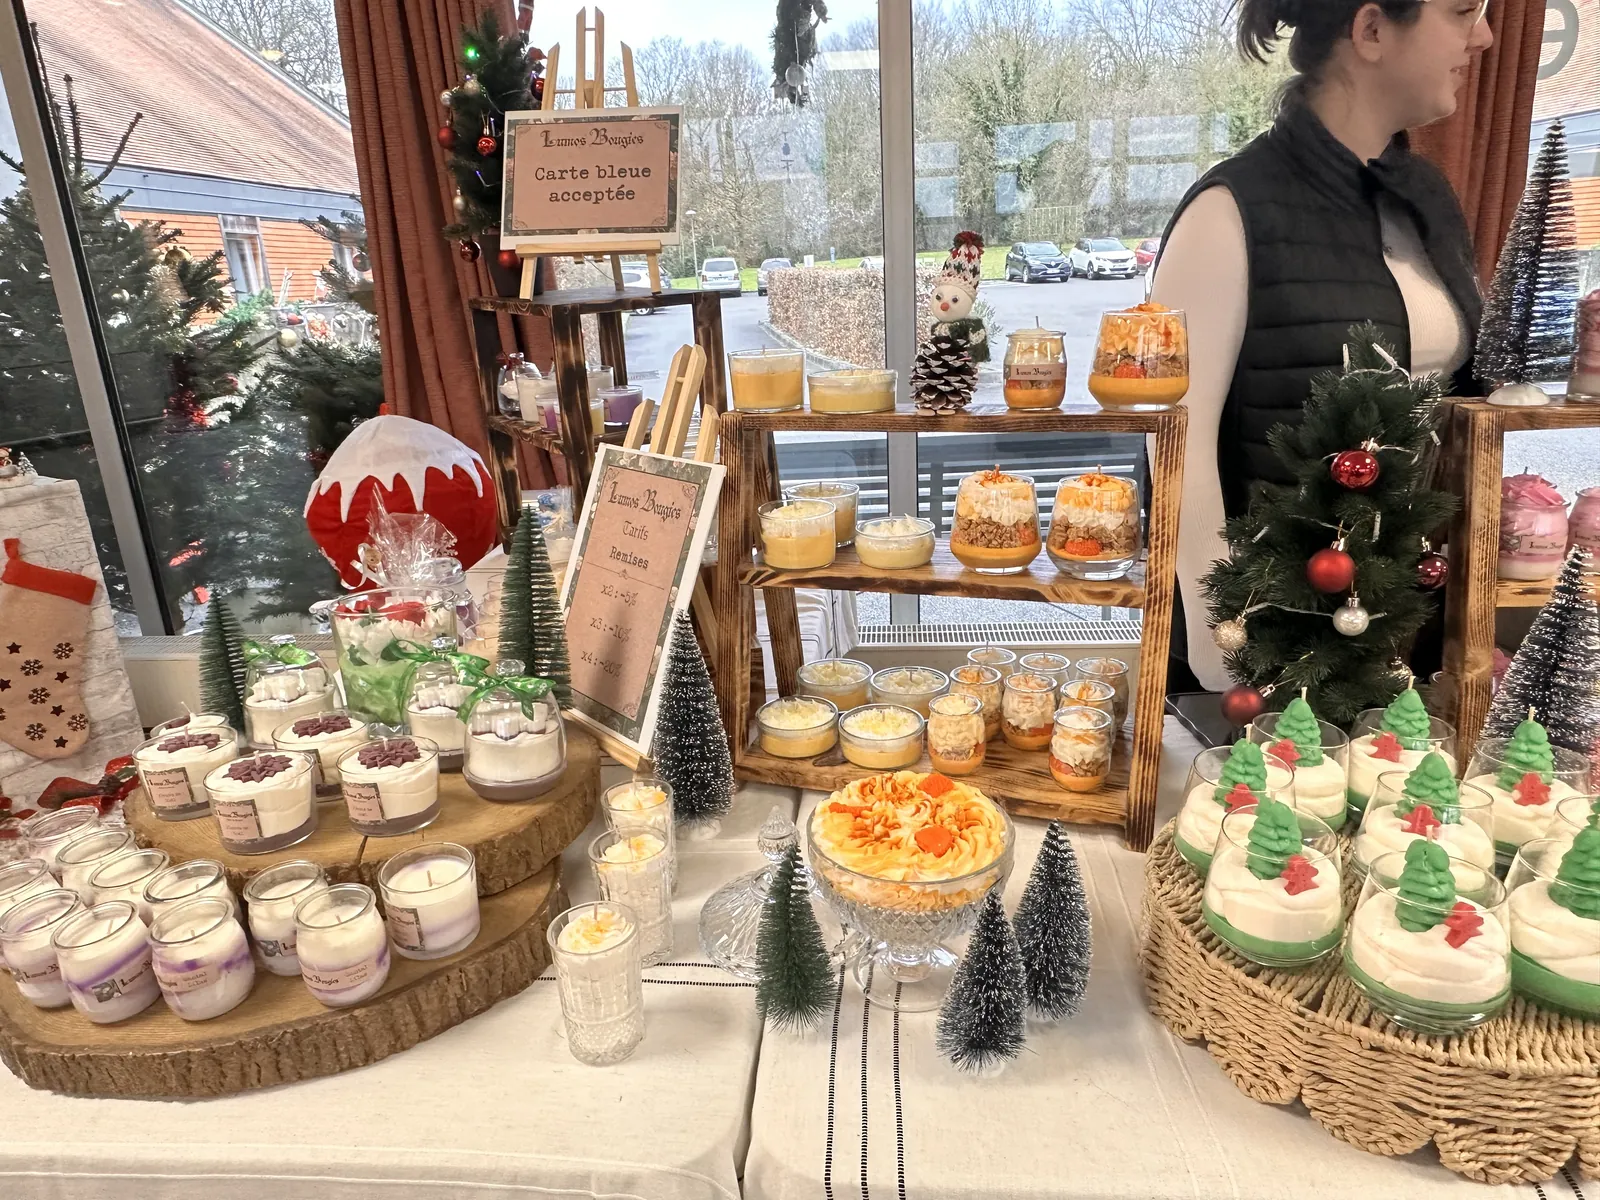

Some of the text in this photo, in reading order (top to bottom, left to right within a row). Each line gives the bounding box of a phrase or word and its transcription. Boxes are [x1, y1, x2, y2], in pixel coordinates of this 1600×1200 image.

[540, 127, 644, 149] Lumos Bougies
[535, 165, 651, 180] Carte bleue
[549, 184, 635, 204] acceptée
[608, 481, 681, 522] Lumos Bougies
[622, 520, 649, 540] Tarifs
[609, 546, 649, 570] Remises
